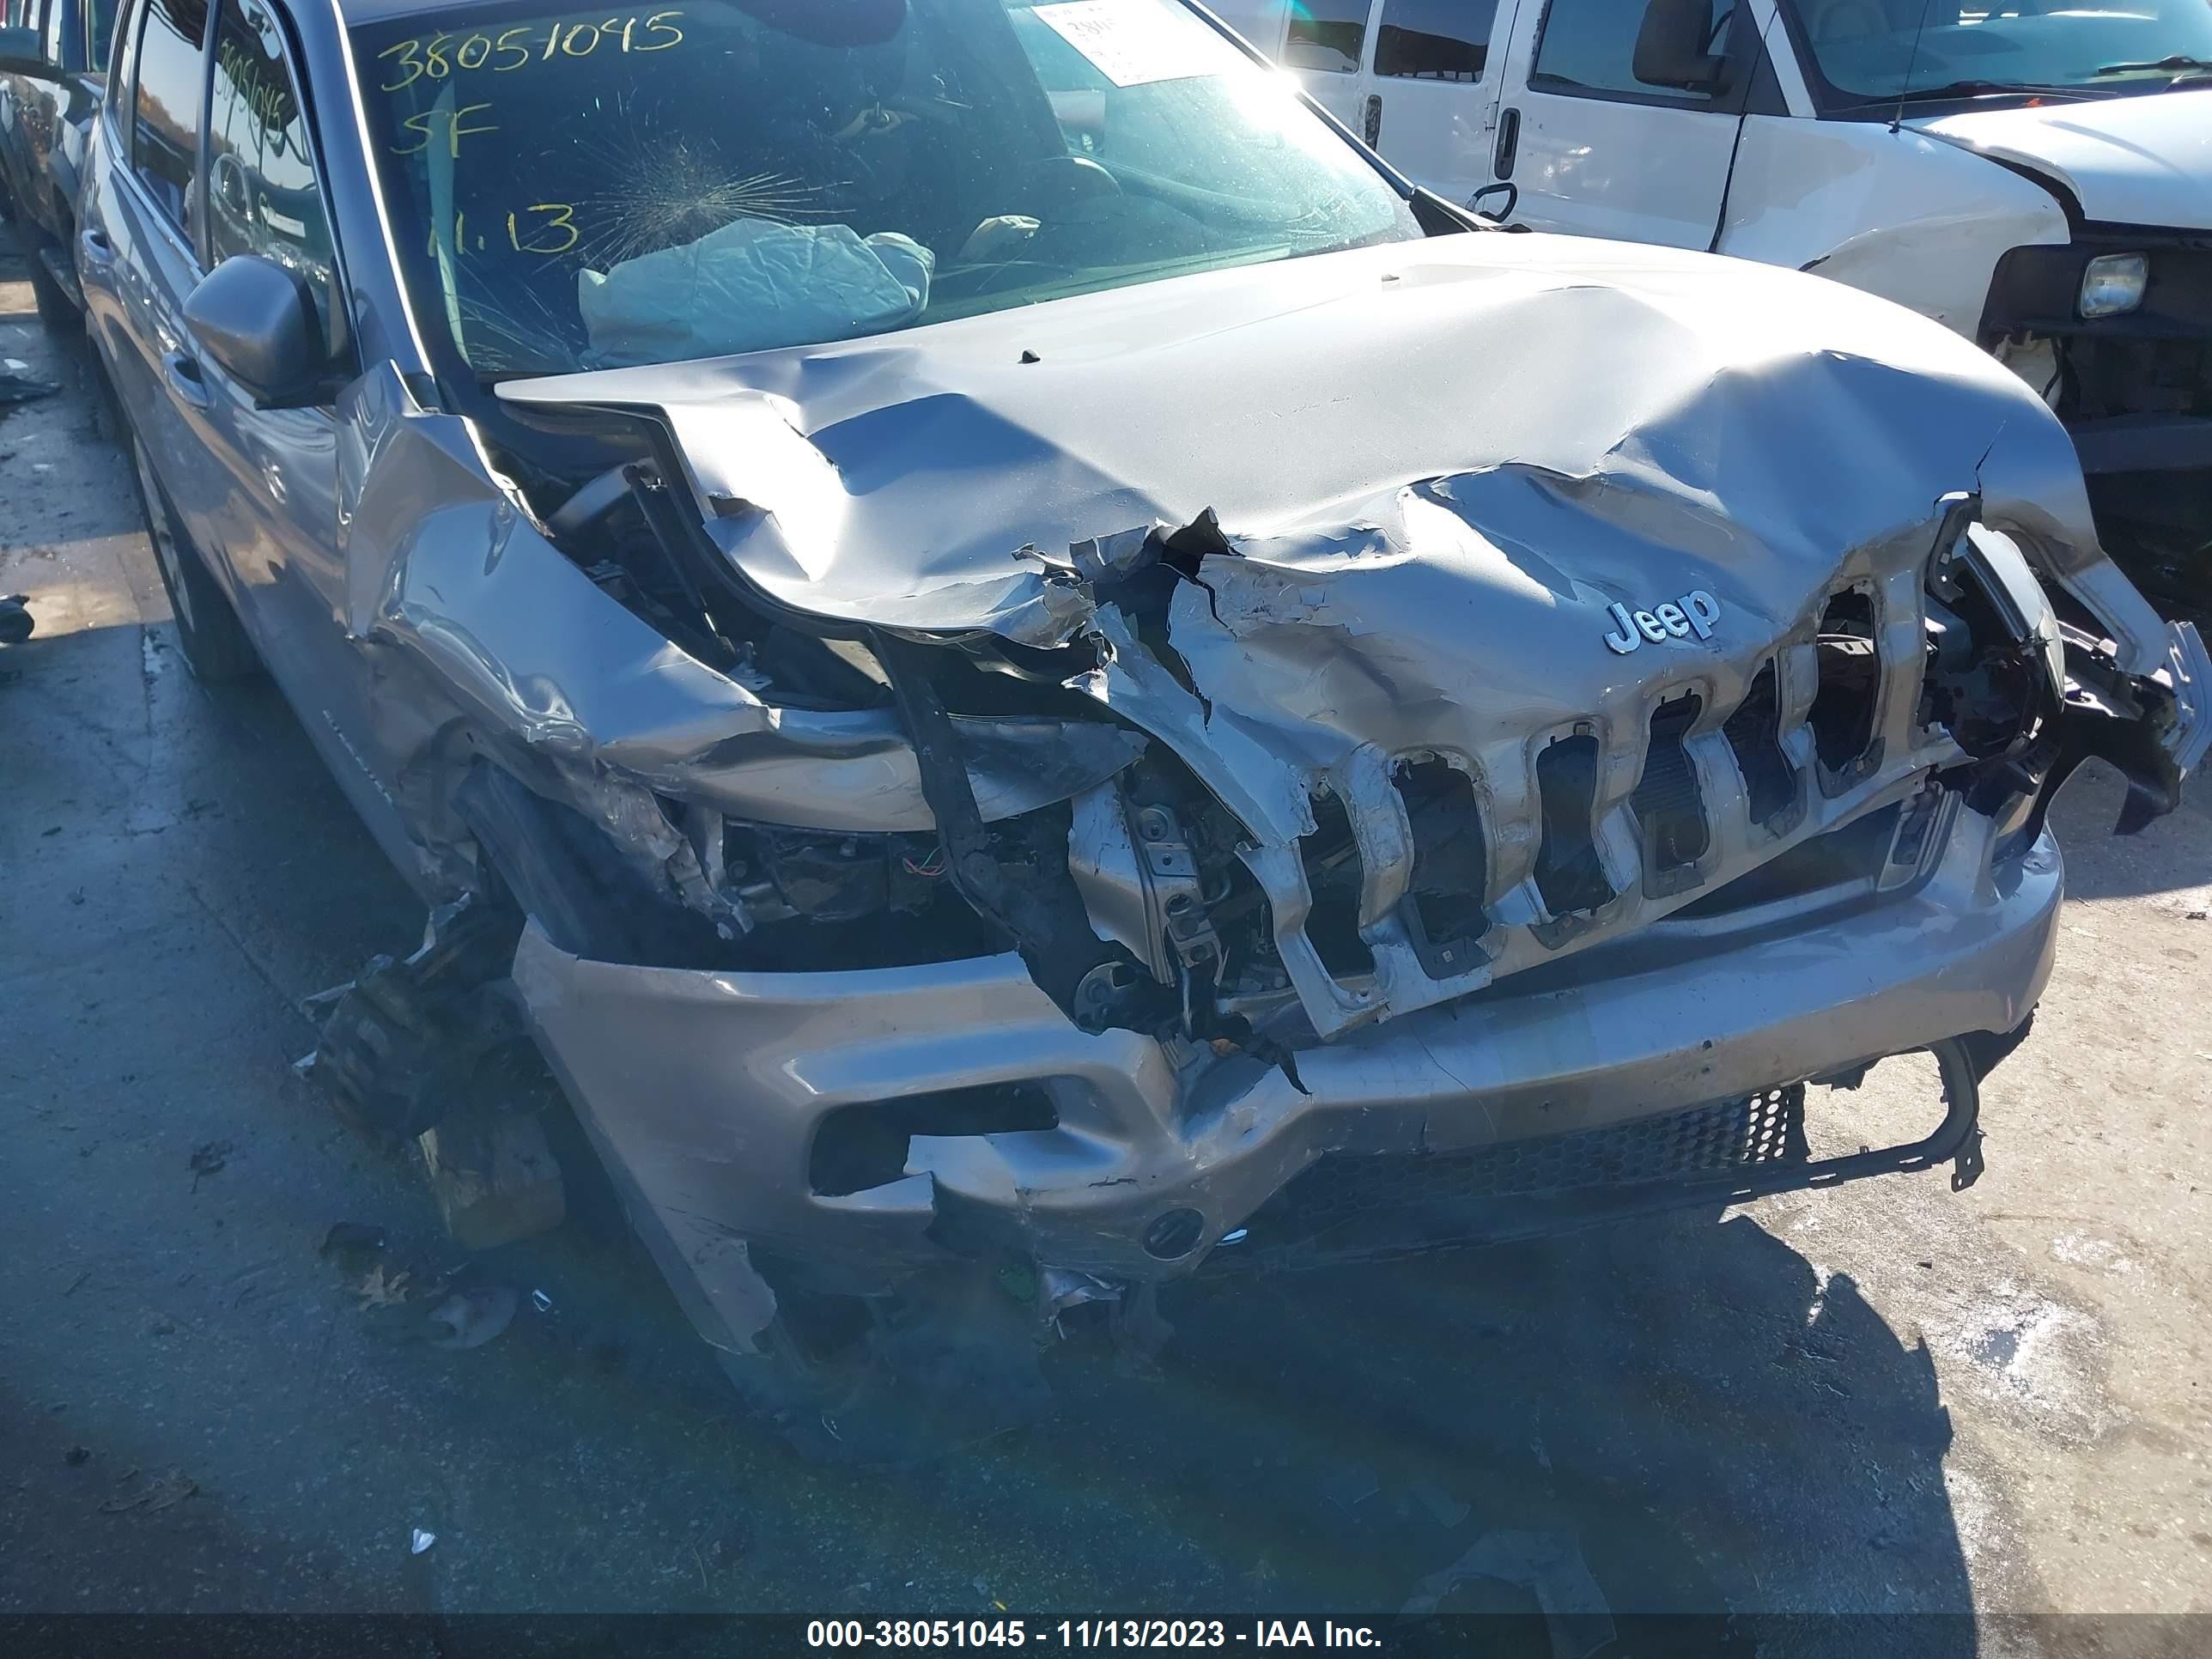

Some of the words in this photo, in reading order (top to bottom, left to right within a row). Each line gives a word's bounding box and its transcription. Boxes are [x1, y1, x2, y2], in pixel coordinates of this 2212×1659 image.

[379, 11, 684, 92] 38051045
[389, 102, 501, 158] SF
[1602, 590, 1721, 655] Jeep
